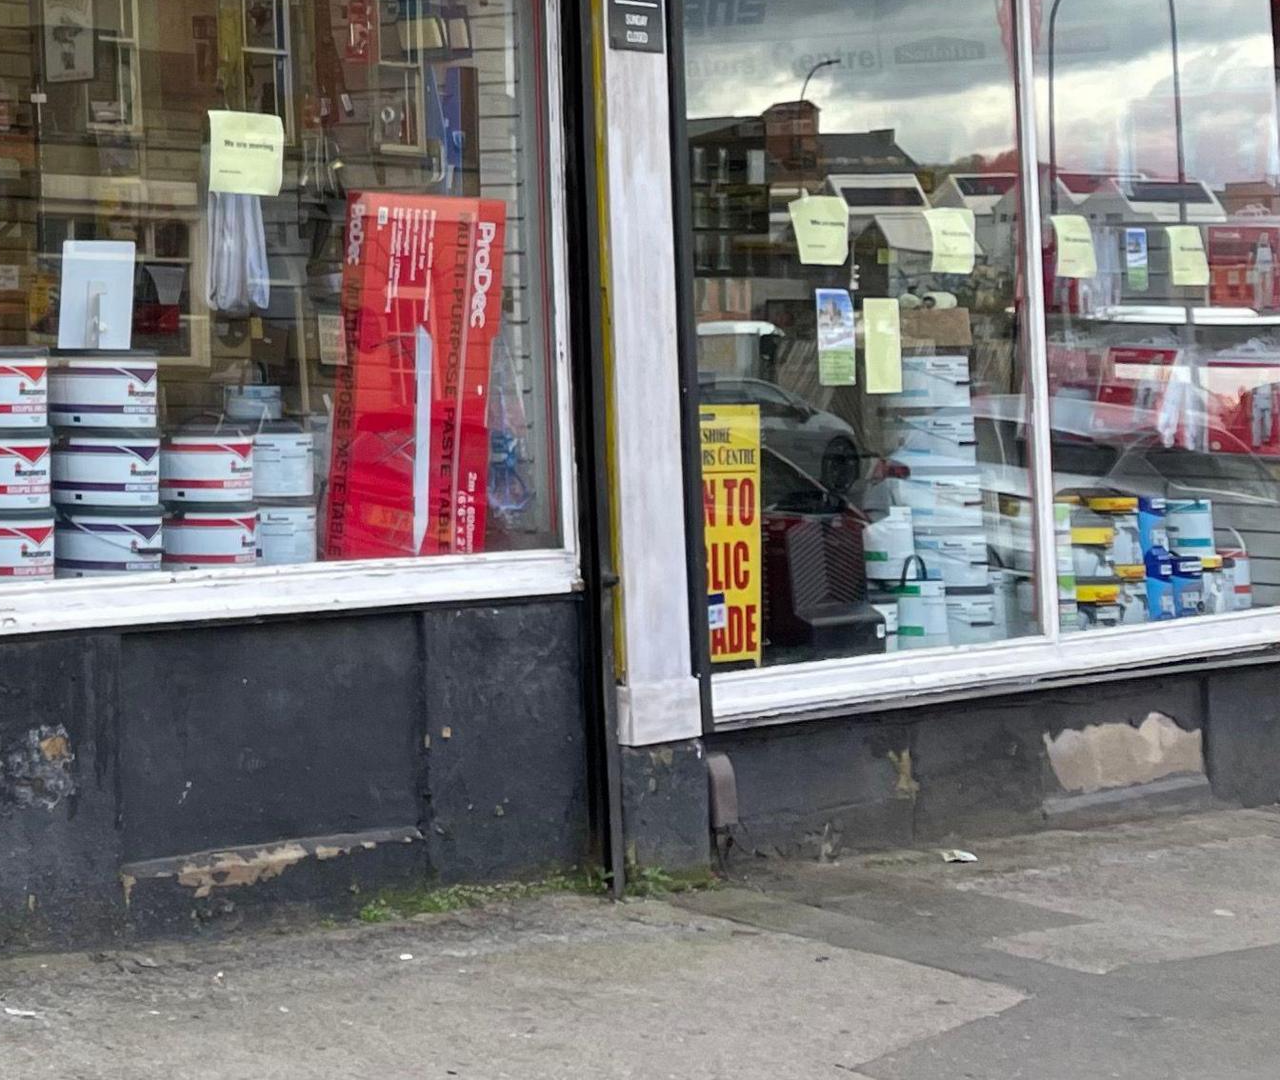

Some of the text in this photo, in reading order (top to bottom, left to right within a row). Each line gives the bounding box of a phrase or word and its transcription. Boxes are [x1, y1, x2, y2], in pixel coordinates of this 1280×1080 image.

[471, 222, 496, 328] ProDec
[440, 407, 456, 477] PASTE
[723, 477, 755, 527] TO
